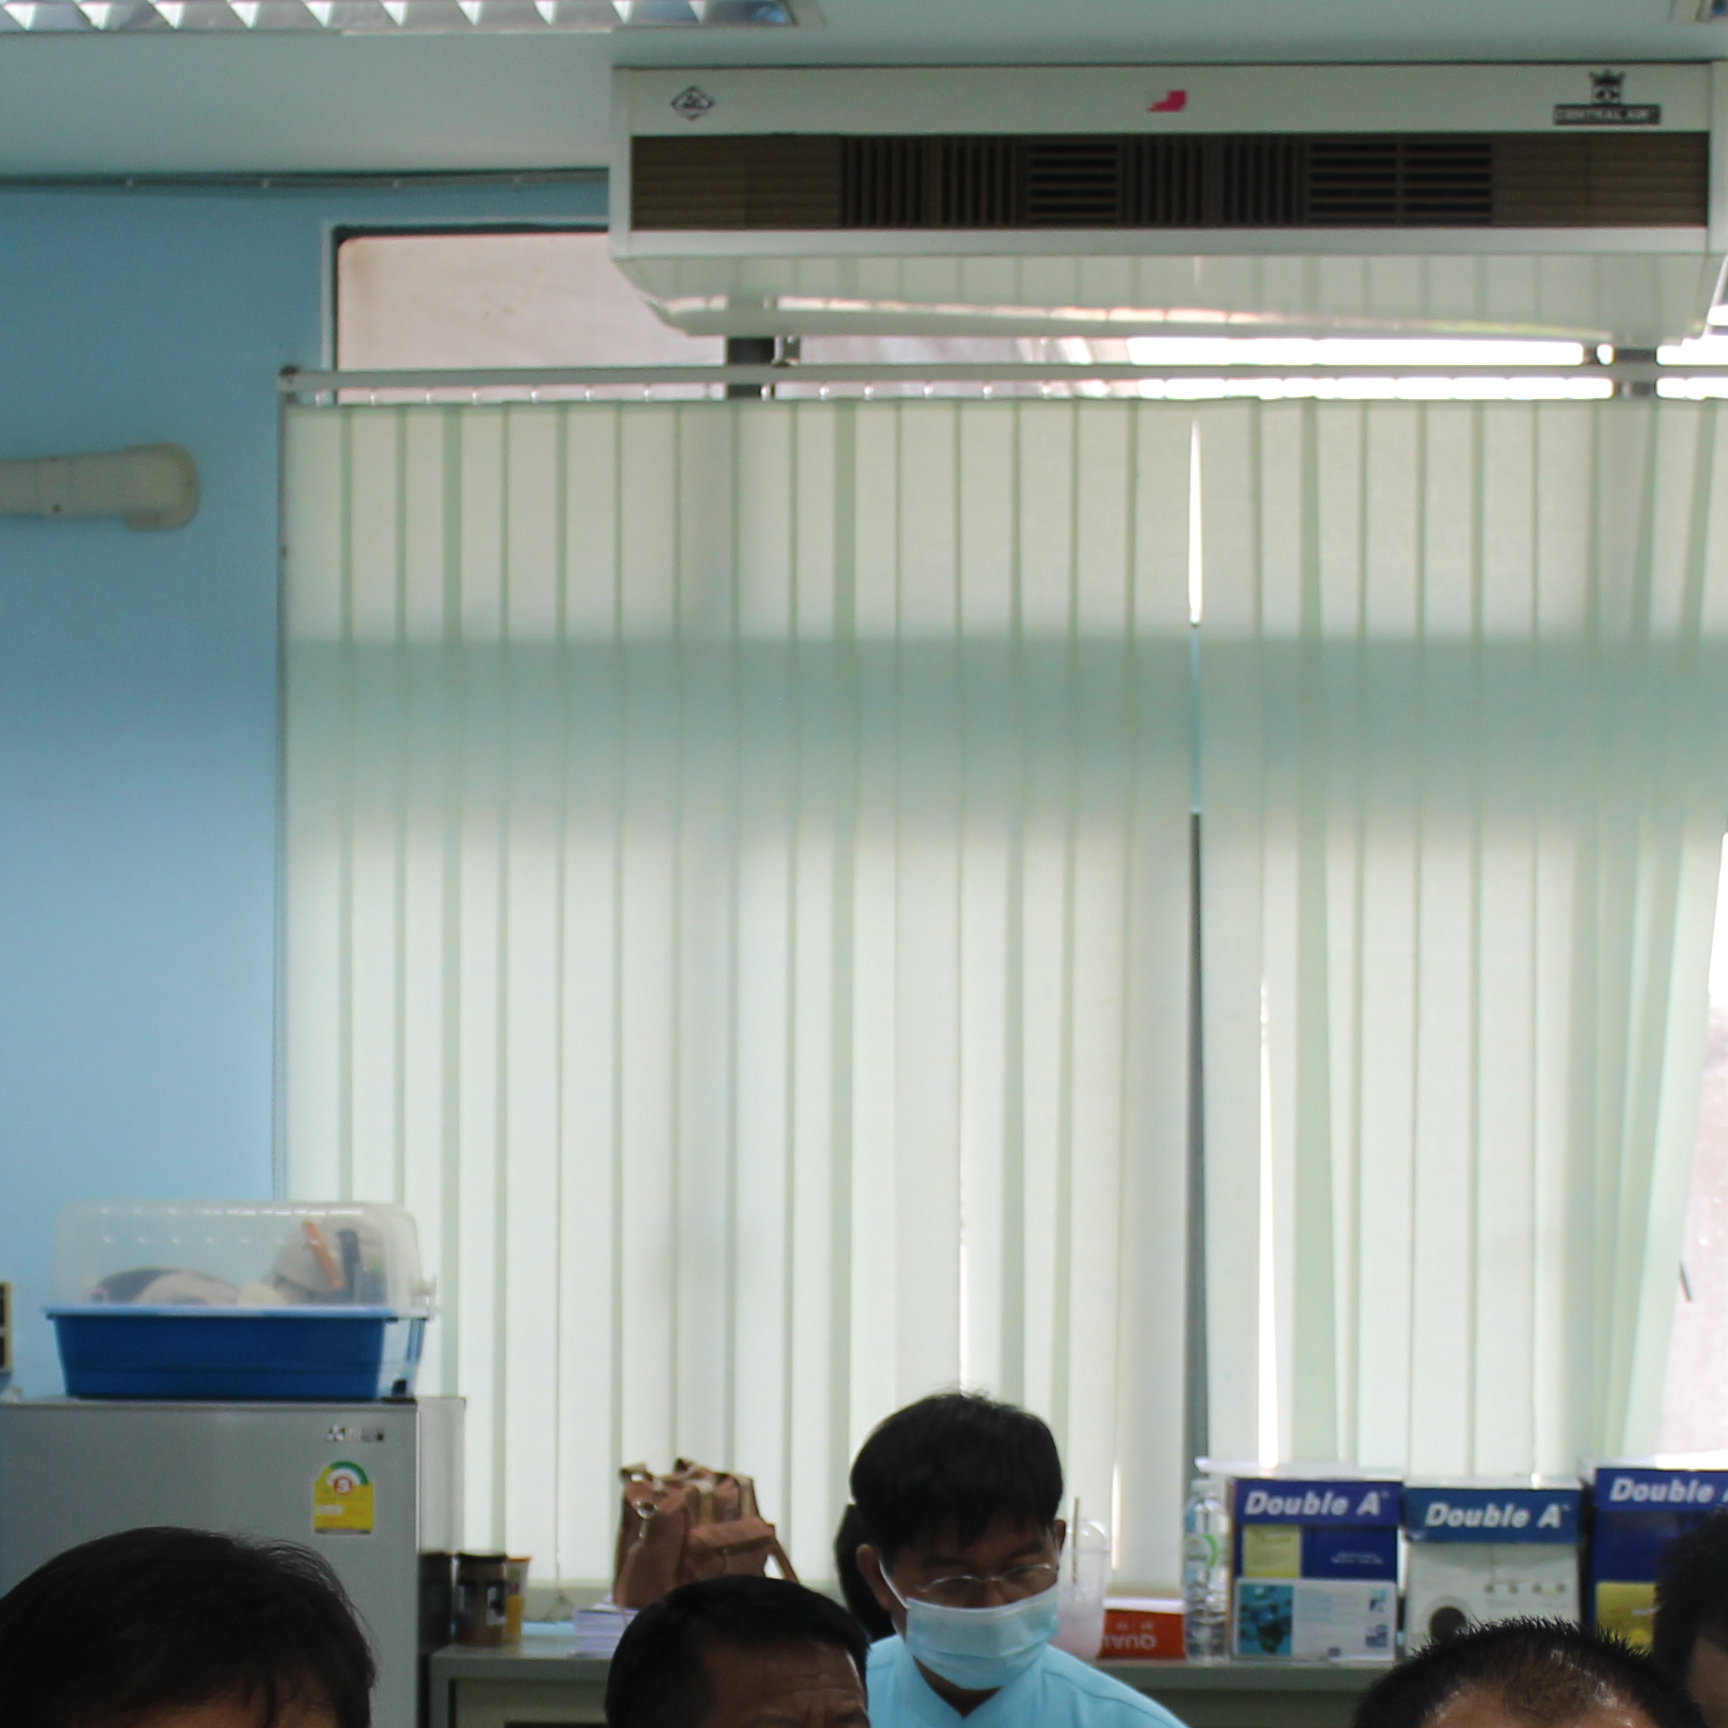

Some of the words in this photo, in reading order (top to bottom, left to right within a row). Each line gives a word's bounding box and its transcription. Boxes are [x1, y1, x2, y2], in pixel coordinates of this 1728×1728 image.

[1244, 1489, 1350, 1516] Double
[1356, 1493, 1381, 1516] A
[1609, 1476, 1716, 1503] Double
[1424, 1501, 1532, 1529] Double
[1537, 1503, 1562, 1529] A
